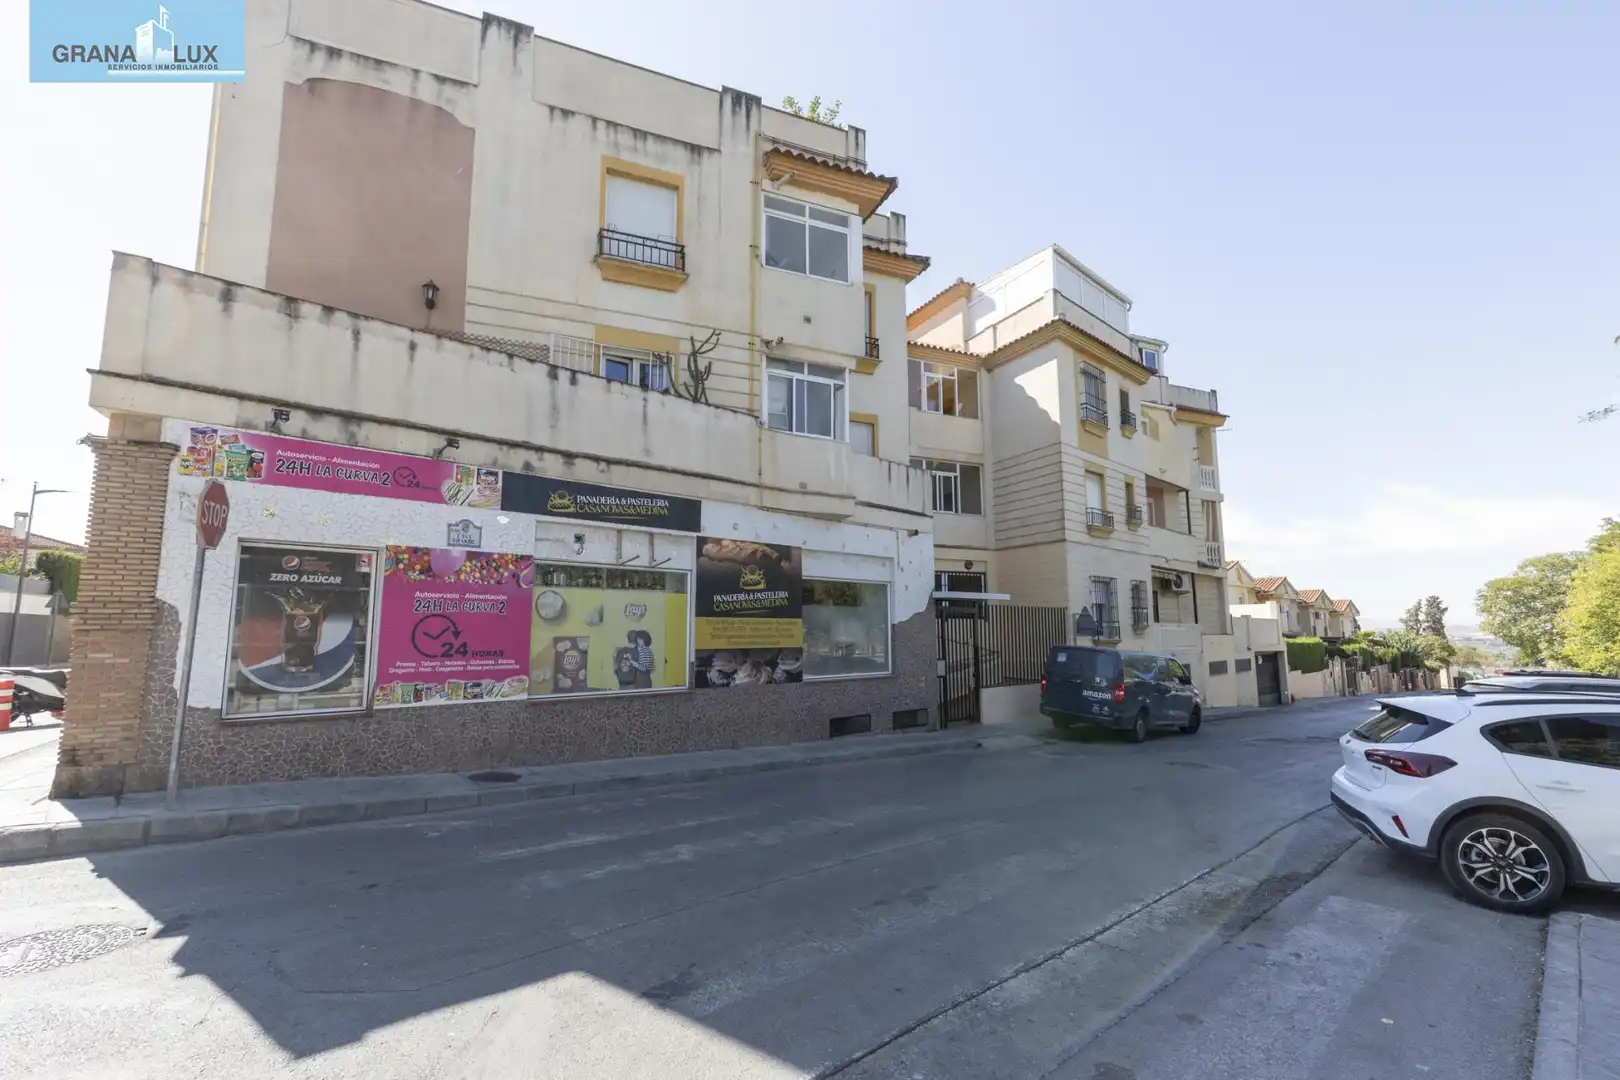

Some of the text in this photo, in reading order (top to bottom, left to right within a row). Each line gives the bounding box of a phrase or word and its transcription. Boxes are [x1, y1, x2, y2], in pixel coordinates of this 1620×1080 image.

[276, 449, 327, 462] Autoservicio
[332, 456, 380, 469] Alimentación
[274, 458, 312, 476] 24H
[315, 464, 332, 478] LA
[335, 467, 380, 484] CURVA
[201, 500, 228, 527] STOP
[269, 572, 342, 584] ZERO AZÚCAR
[414, 591, 460, 599] Autoservicio
[464, 592, 508, 601] Alimentación
[414, 599, 507, 615] 24H LA CURVA 2
[439, 642, 469, 658] 24
[472, 650, 504, 658] HORAS
[1082, 690, 1112, 700] amazon
